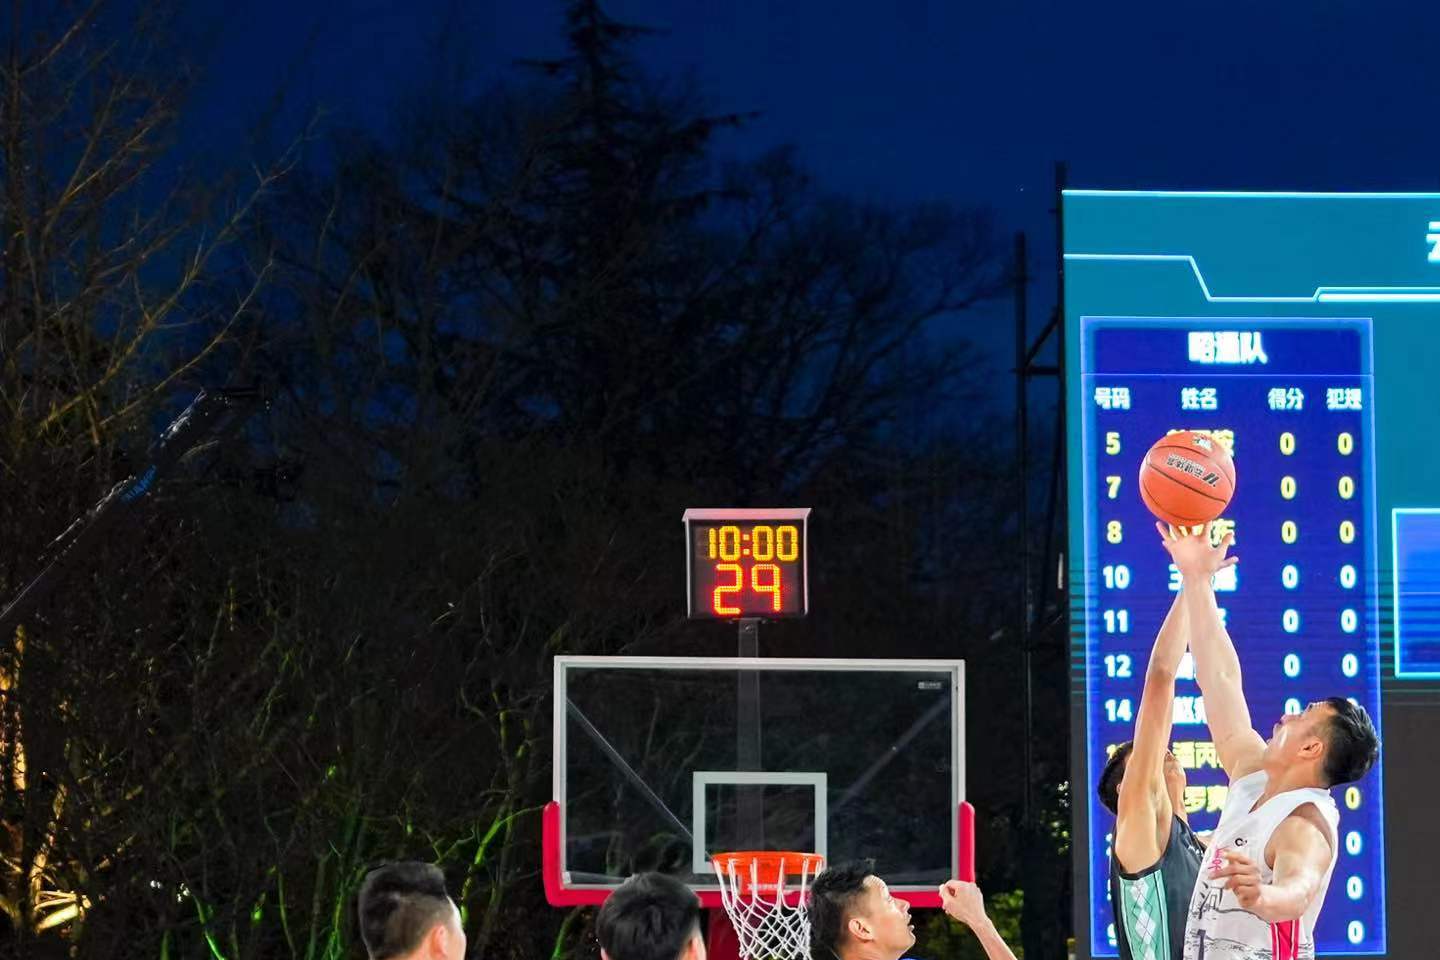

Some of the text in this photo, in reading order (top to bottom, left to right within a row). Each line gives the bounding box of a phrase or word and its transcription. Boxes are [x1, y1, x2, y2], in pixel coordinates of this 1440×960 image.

[1095, 388, 1362, 409] 号码 姓名 得分 犯规
[1106, 432, 1352, 455] 5 0 0
[1106, 476, 1354, 499] 7 0 0
[707, 525, 800, 562] 10:00
[1107, 521, 1355, 543] 8 0 0
[1103, 565, 1355, 588] 10 0 0
[712, 562, 783, 616] 29
[1104, 609, 1356, 632] 11 0 0
[1105, 654, 1357, 677] 12 0 0
[1105, 698, 1132, 721] 14
[1345, 787, 1361, 809] 0
[1346, 832, 1361, 854] 0
[1348, 876, 1362, 899] 0
[1349, 921, 1363, 943] 0
